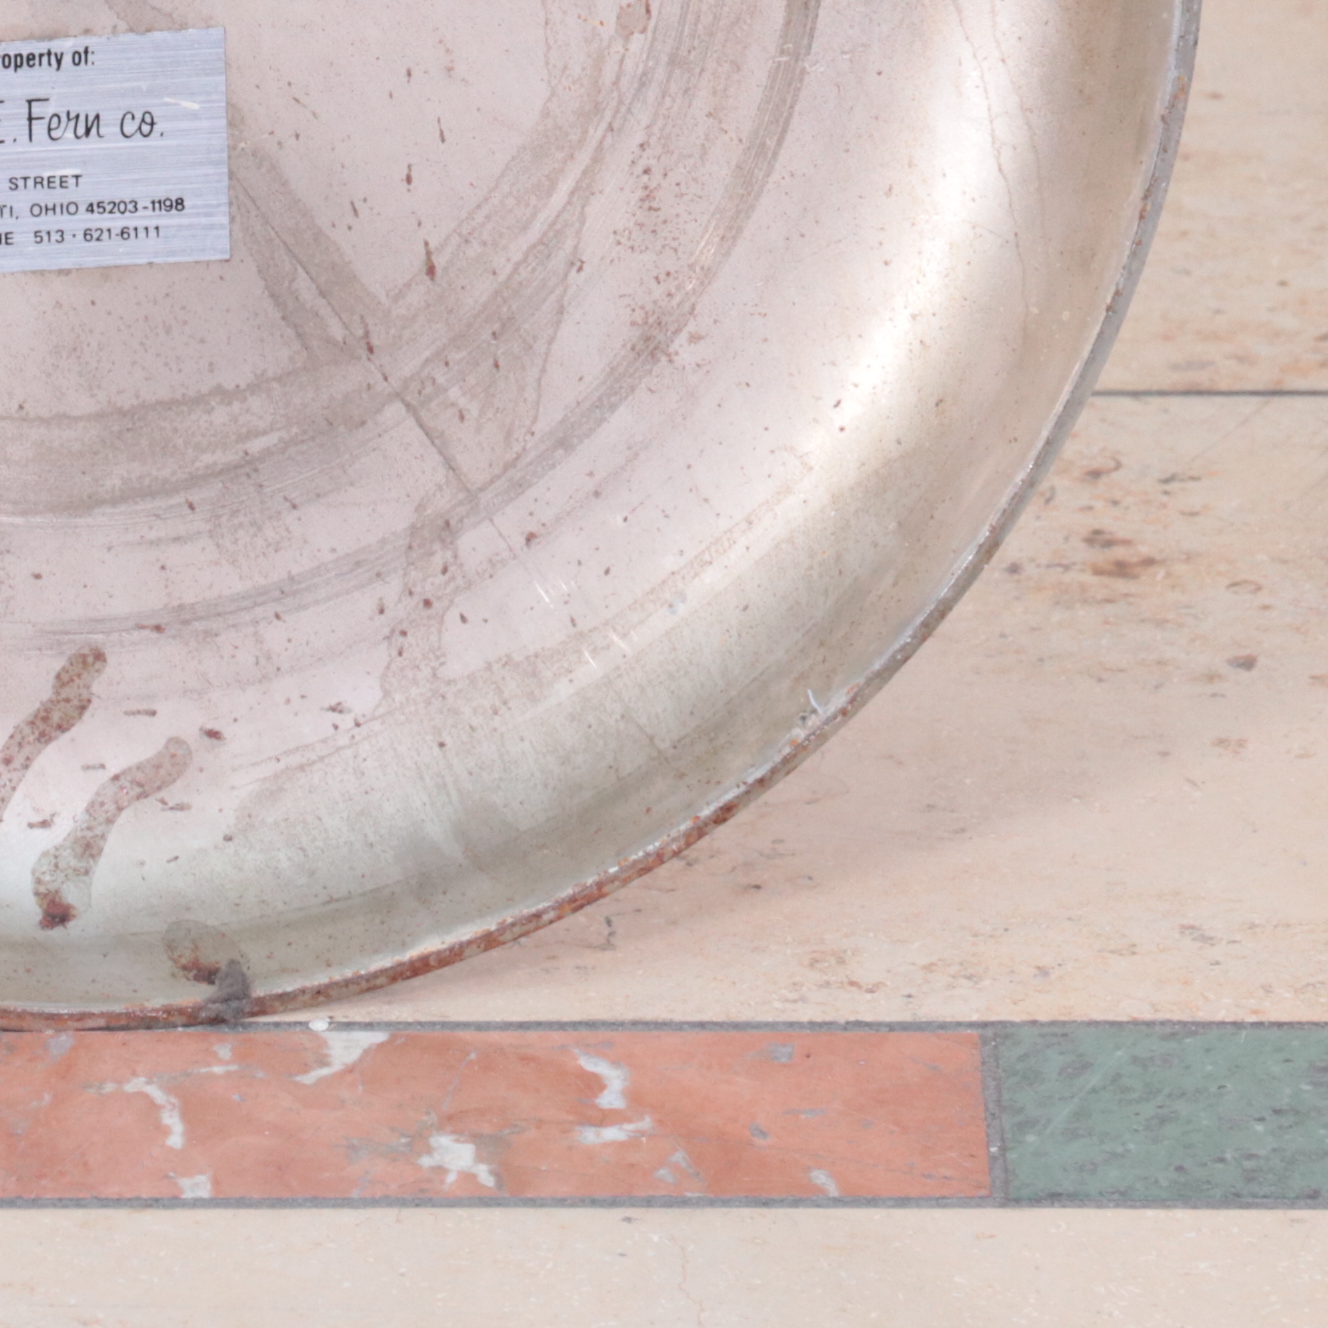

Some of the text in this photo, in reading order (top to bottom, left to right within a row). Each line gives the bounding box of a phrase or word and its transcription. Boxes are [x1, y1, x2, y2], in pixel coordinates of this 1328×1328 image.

[26, 98, 105, 143] Fern
[8, 174, 83, 192] STREET
[29, 201, 79, 218] OHIO
